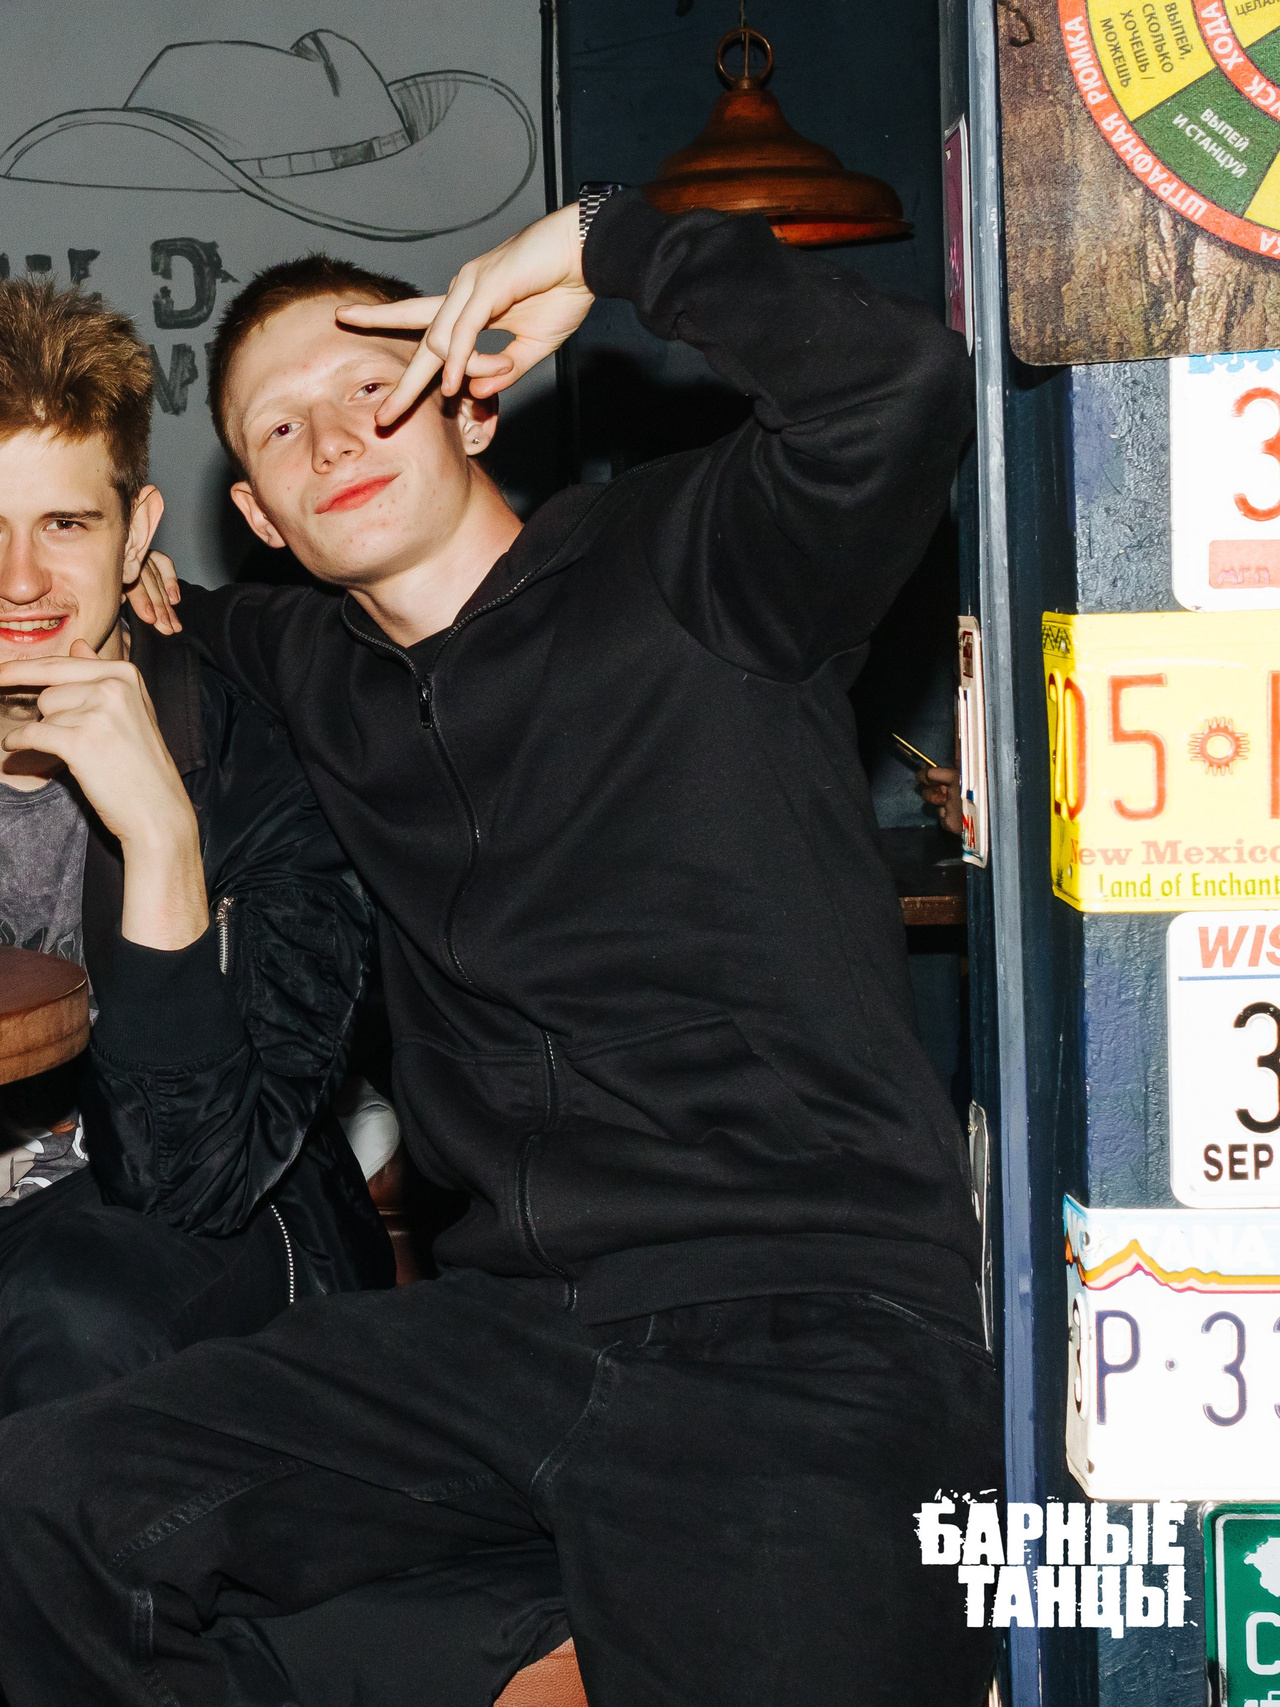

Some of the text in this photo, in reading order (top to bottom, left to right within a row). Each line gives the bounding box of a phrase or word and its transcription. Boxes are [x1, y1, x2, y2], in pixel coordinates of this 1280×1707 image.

[1100, 17, 1132, 88] МОЖЕШЬ
[1120, 9, 1151, 73] ХОЧЕШЬ
[1142, 3, 1174, 73] СКОЛЬКО
[1164, 2, 1194, 60] ВЫПЕЙ,
[1201, 1, 1245, 71] ХОДА
[1064, 15, 1208, 220] ШТРАФНАЯ РЮМКА
[1172, 113, 1248, 178] И СТАНЦУЙ
[1200, 108, 1250, 152] ВЫПЕЙ
[1070, 838, 1133, 867] New
[1098, 873, 1152, 899] Land
[1161, 873, 1182, 898] of
[1203, 1143, 1275, 1183] SEP
